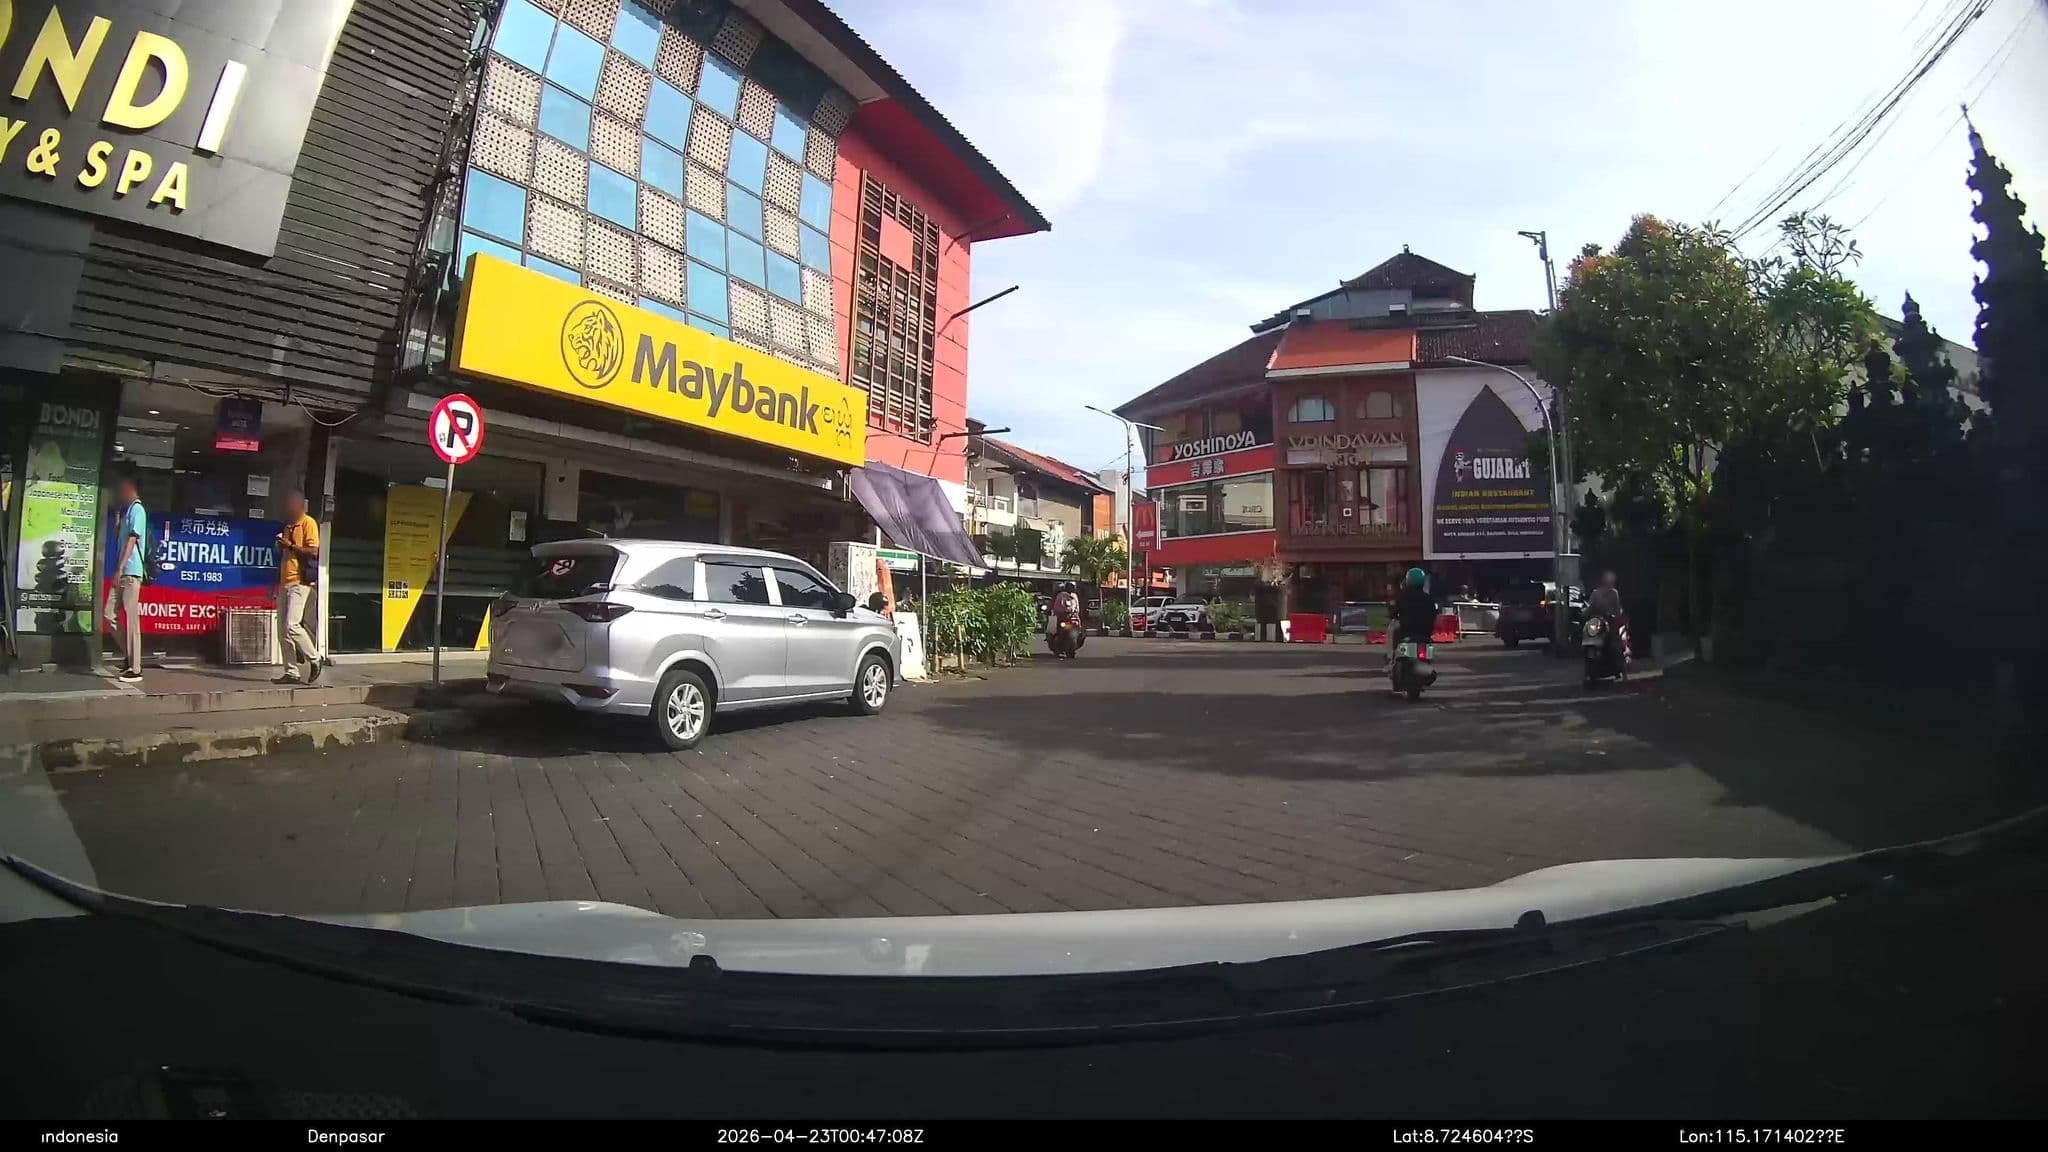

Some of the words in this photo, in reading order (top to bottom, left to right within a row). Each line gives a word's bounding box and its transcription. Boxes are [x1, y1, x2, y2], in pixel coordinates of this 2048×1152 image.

[26, 127, 61, 176] &
[77, 140, 188, 210] SPA
[631, 333, 820, 436] Maybank
[40, 403, 100, 429] BONDI
[1174, 430, 1256, 459] YOSHINOYA
[1452, 489, 1480, 498] INDIAN
[181, 519, 230, 537] 货币兑换
[159, 540, 230, 564] CENTRAL
[233, 545, 274, 566] KUTA
[181, 570, 200, 581] EST.
[202, 572, 223, 583] 1983
[137, 602, 186, 618] MONEY
